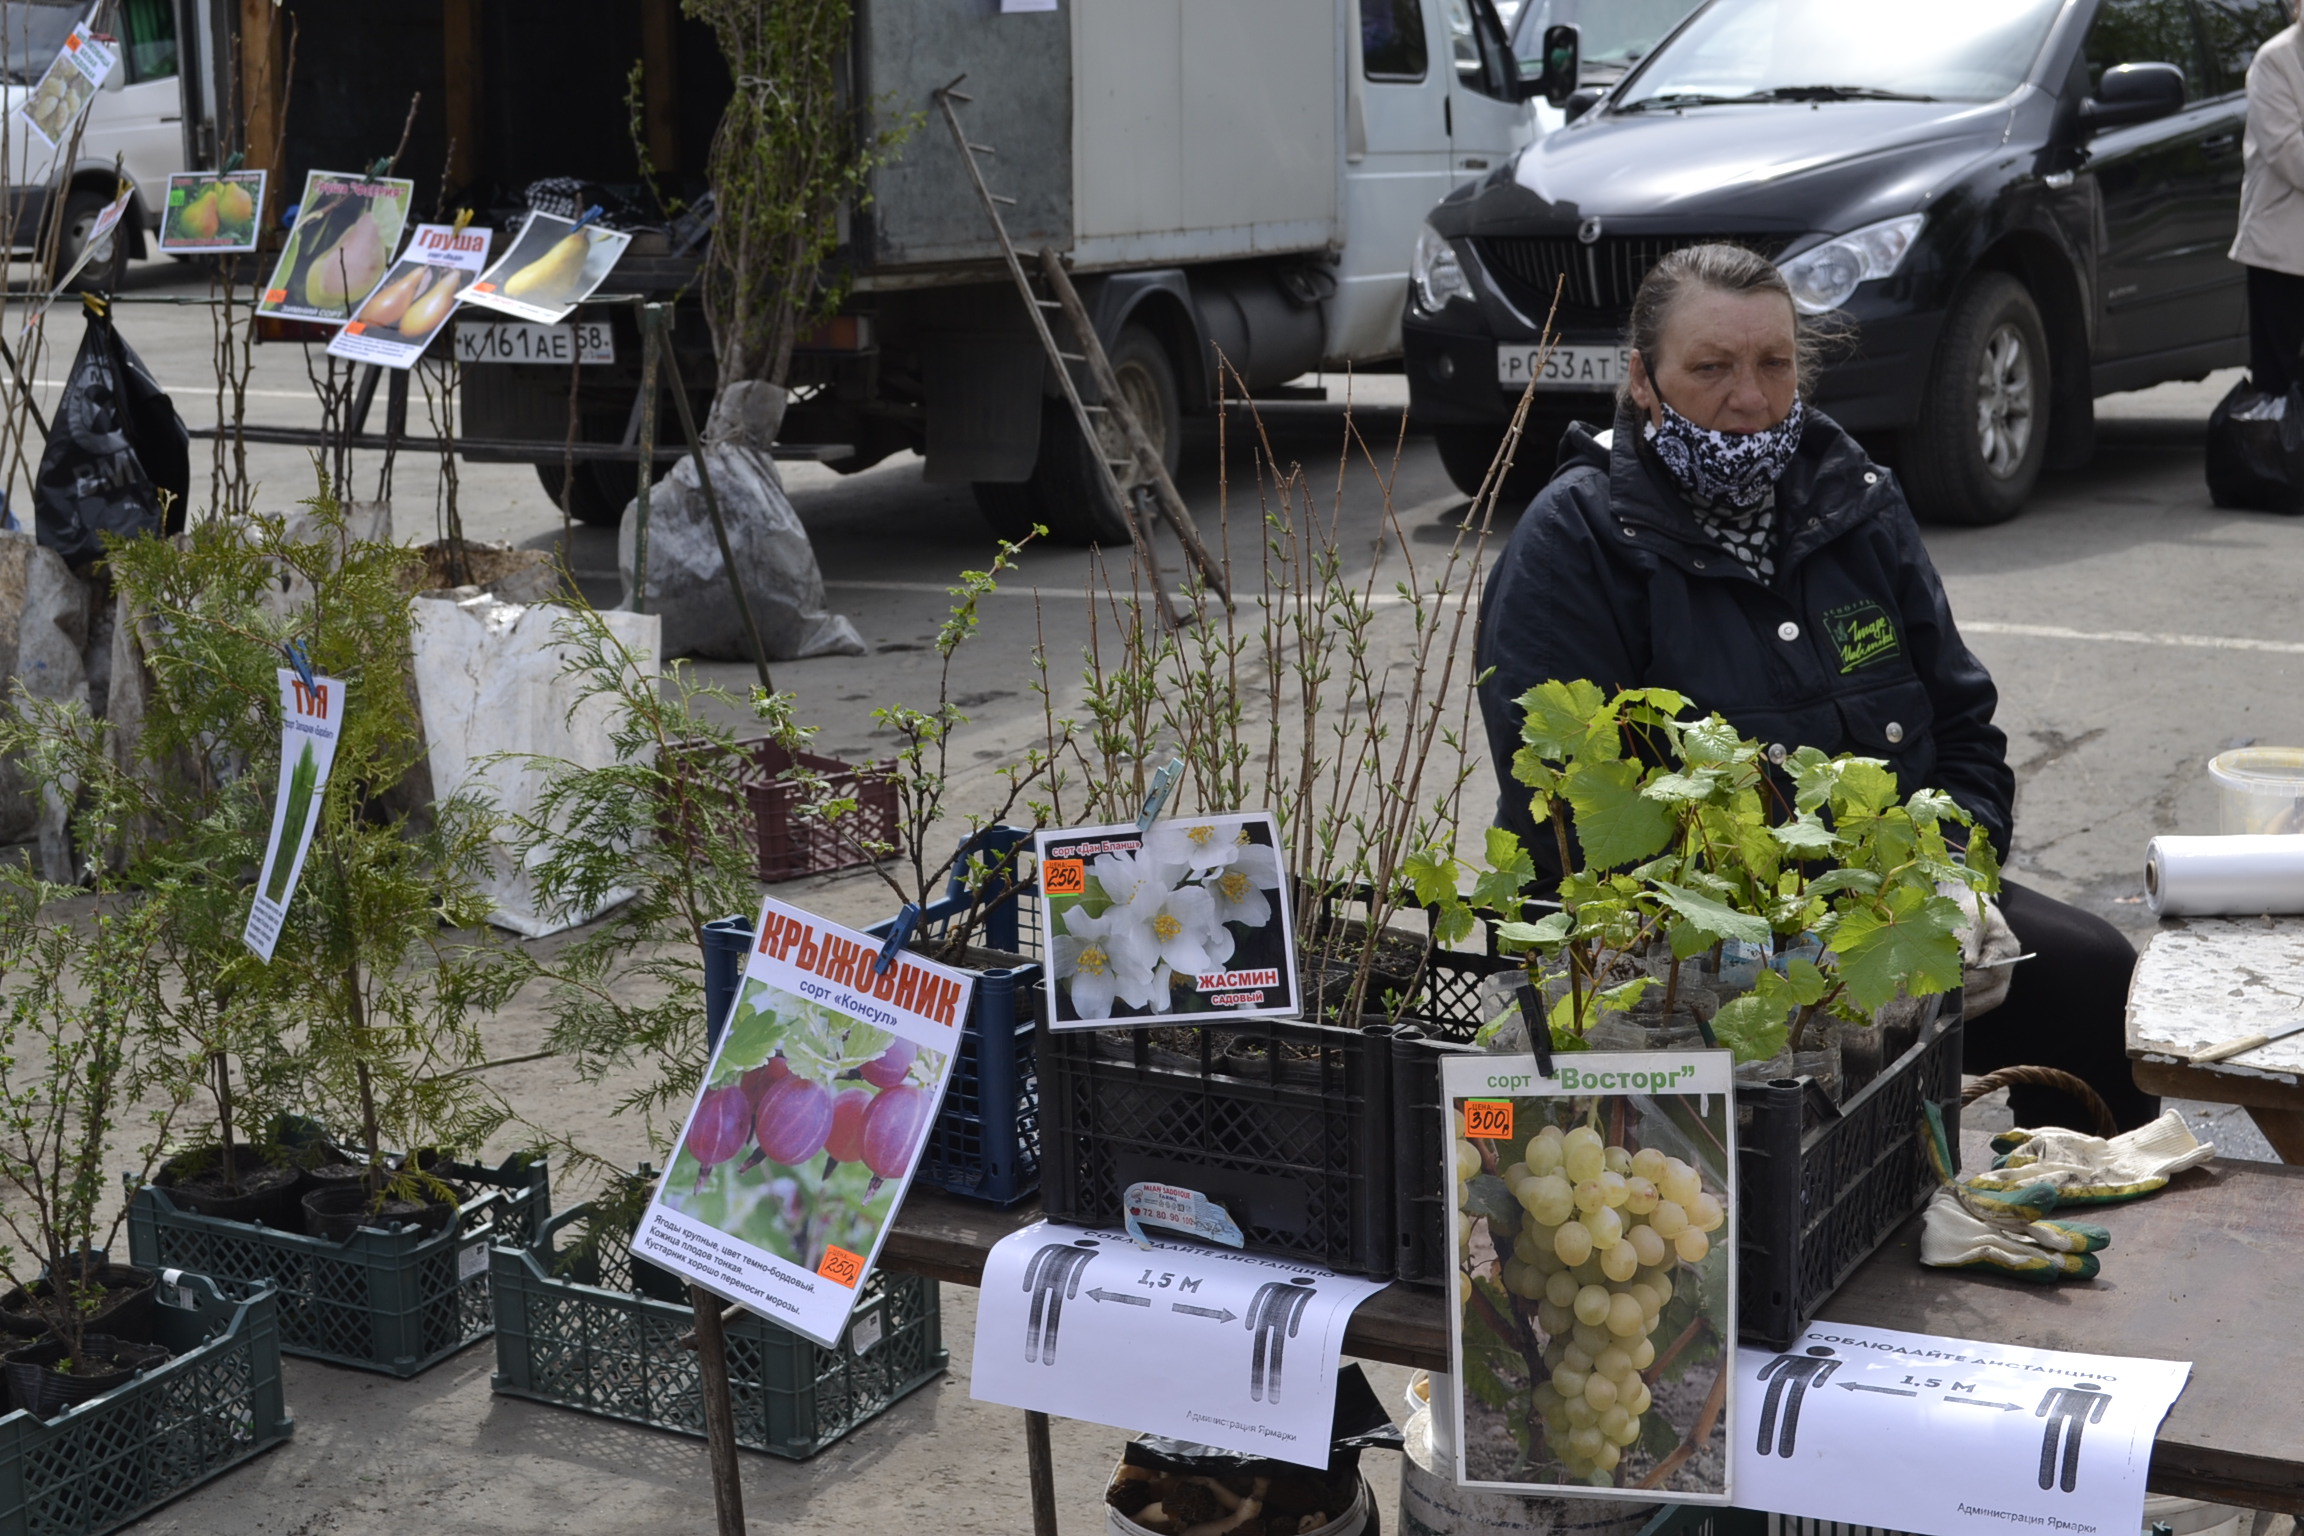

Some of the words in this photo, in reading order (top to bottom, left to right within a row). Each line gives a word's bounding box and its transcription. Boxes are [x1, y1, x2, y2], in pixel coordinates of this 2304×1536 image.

[313, 180, 348, 195] Груша
[418, 228, 484, 253] Груша
[319, 309, 342, 318] СОРТ
[464, 327, 567, 358] К161АЕ
[1848, 617, 1887, 642] Image
[291, 680, 328, 720] ТУЯ
[1052, 847, 1074, 857] сорт
[1077, 843, 1100, 855] «Дан
[1103, 840, 1141, 851] Бланш»
[758, 911, 962, 1027] КРЫЖОВНИК
[1199, 970, 1277, 989] ЖАСМИН
[800, 981, 832, 1000] сорт
[834, 993, 897, 1026] «Консул»
[1212, 992, 1263, 1005] САДОВЫЙ
[1487, 1074, 1531, 1091] сорт
[1143, 1184, 1161, 1193] MIAN
[1143, 1208, 1153, 1217] 72
[1156, 1210, 1166, 1220] 80
[1170, 1213, 1179, 1222] 90
[650, 1226, 680, 1247] Кожица
[681, 1241, 713, 1260] плодов
[714, 1257, 743, 1275] тонкая.
[655, 1214, 681, 1233] Ягоды
[683, 1229, 719, 1252] крупные,
[722, 1246, 741, 1260] цвет
[743, 1255, 815, 1294] темно-бордовый.
[1084, 1230, 1212, 1257] СОБЛДАЙТЕ
[1215, 1252, 1335, 1278] ДИСТАНЦИЮ
[645, 1238, 686, 1263] Кустарник
[688, 1258, 719, 1278] хорошо
[720, 1273, 765, 1298] переносит
[766, 1295, 800, 1315] морозы.
[1138, 1269, 1175, 1289] 1,5
[1179, 1276, 1203, 1294] М
[1807, 1333, 1966, 1362] СОБЛЮДАЙТЕ
[1970, 1358, 2117, 1382] ДИСТАНЦИЮ
[1951, 1381, 1977, 1393] М
[1186, 1410, 1256, 1432] Администрация
[1258, 1425, 1297, 1442] Ярмарки
[1957, 1502, 2044, 1525] Администрация
[2047, 1517, 2097, 1534] Ярмарки
